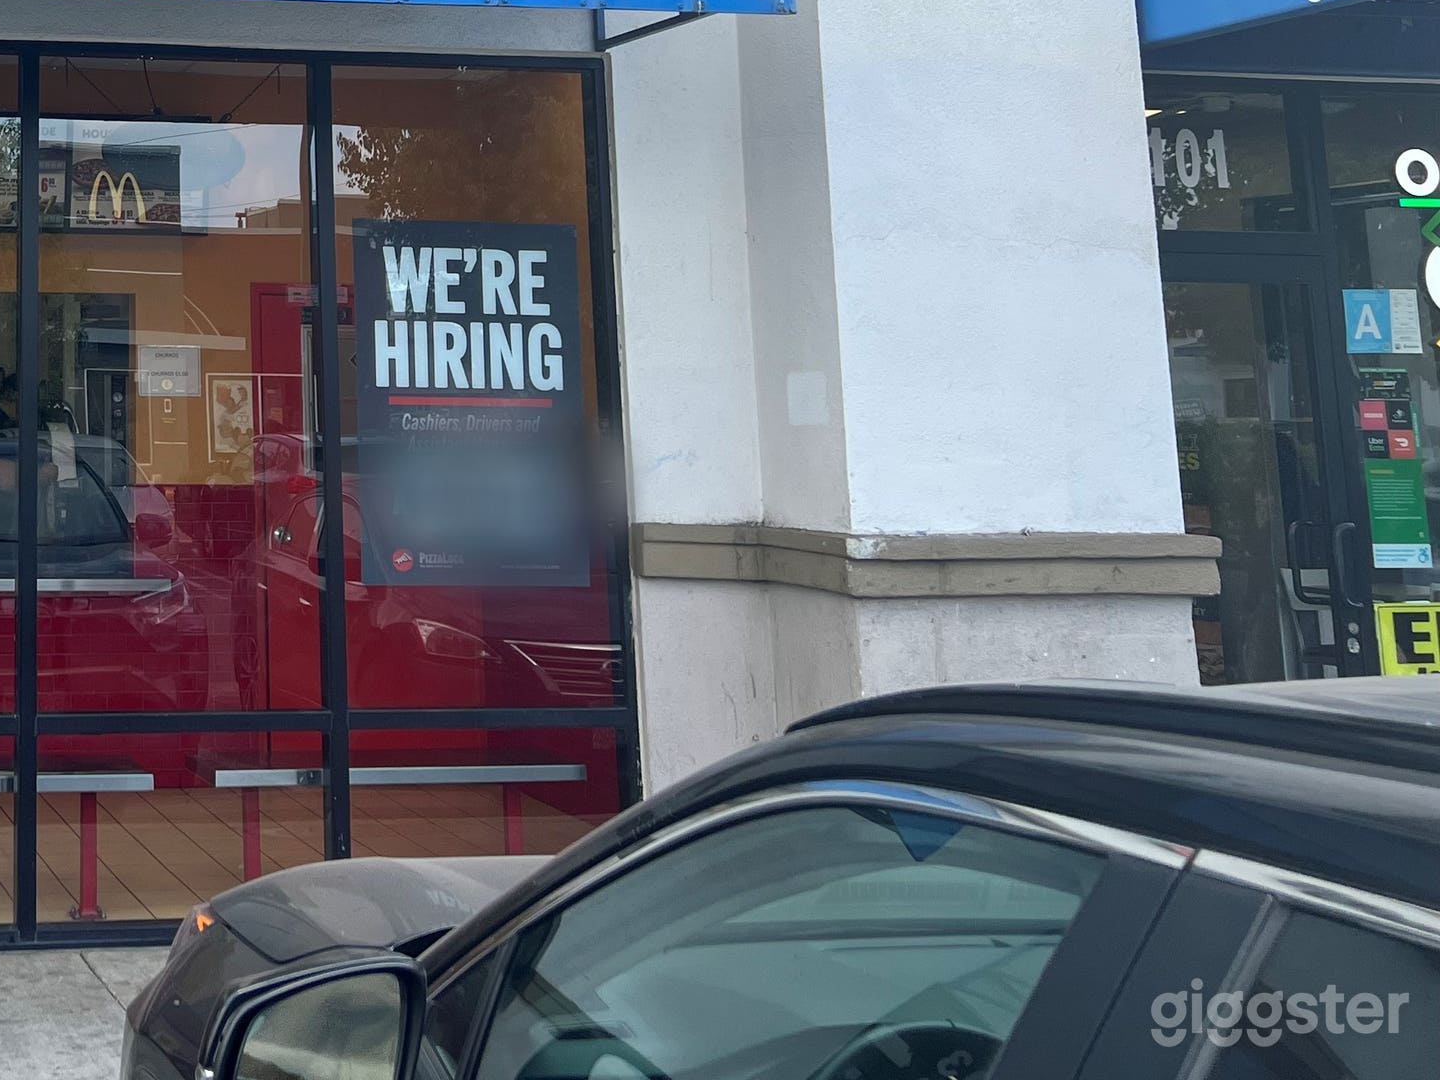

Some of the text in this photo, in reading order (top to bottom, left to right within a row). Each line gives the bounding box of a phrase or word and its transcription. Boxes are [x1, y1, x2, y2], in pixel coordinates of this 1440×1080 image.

[382, 245, 552, 316] WE'RE
[1354, 303, 1382, 340] A
[373, 319, 565, 392] HIRING
[401, 412, 541, 433] Cashiers, Drivers and
[1392, 612, 1440, 665] E
